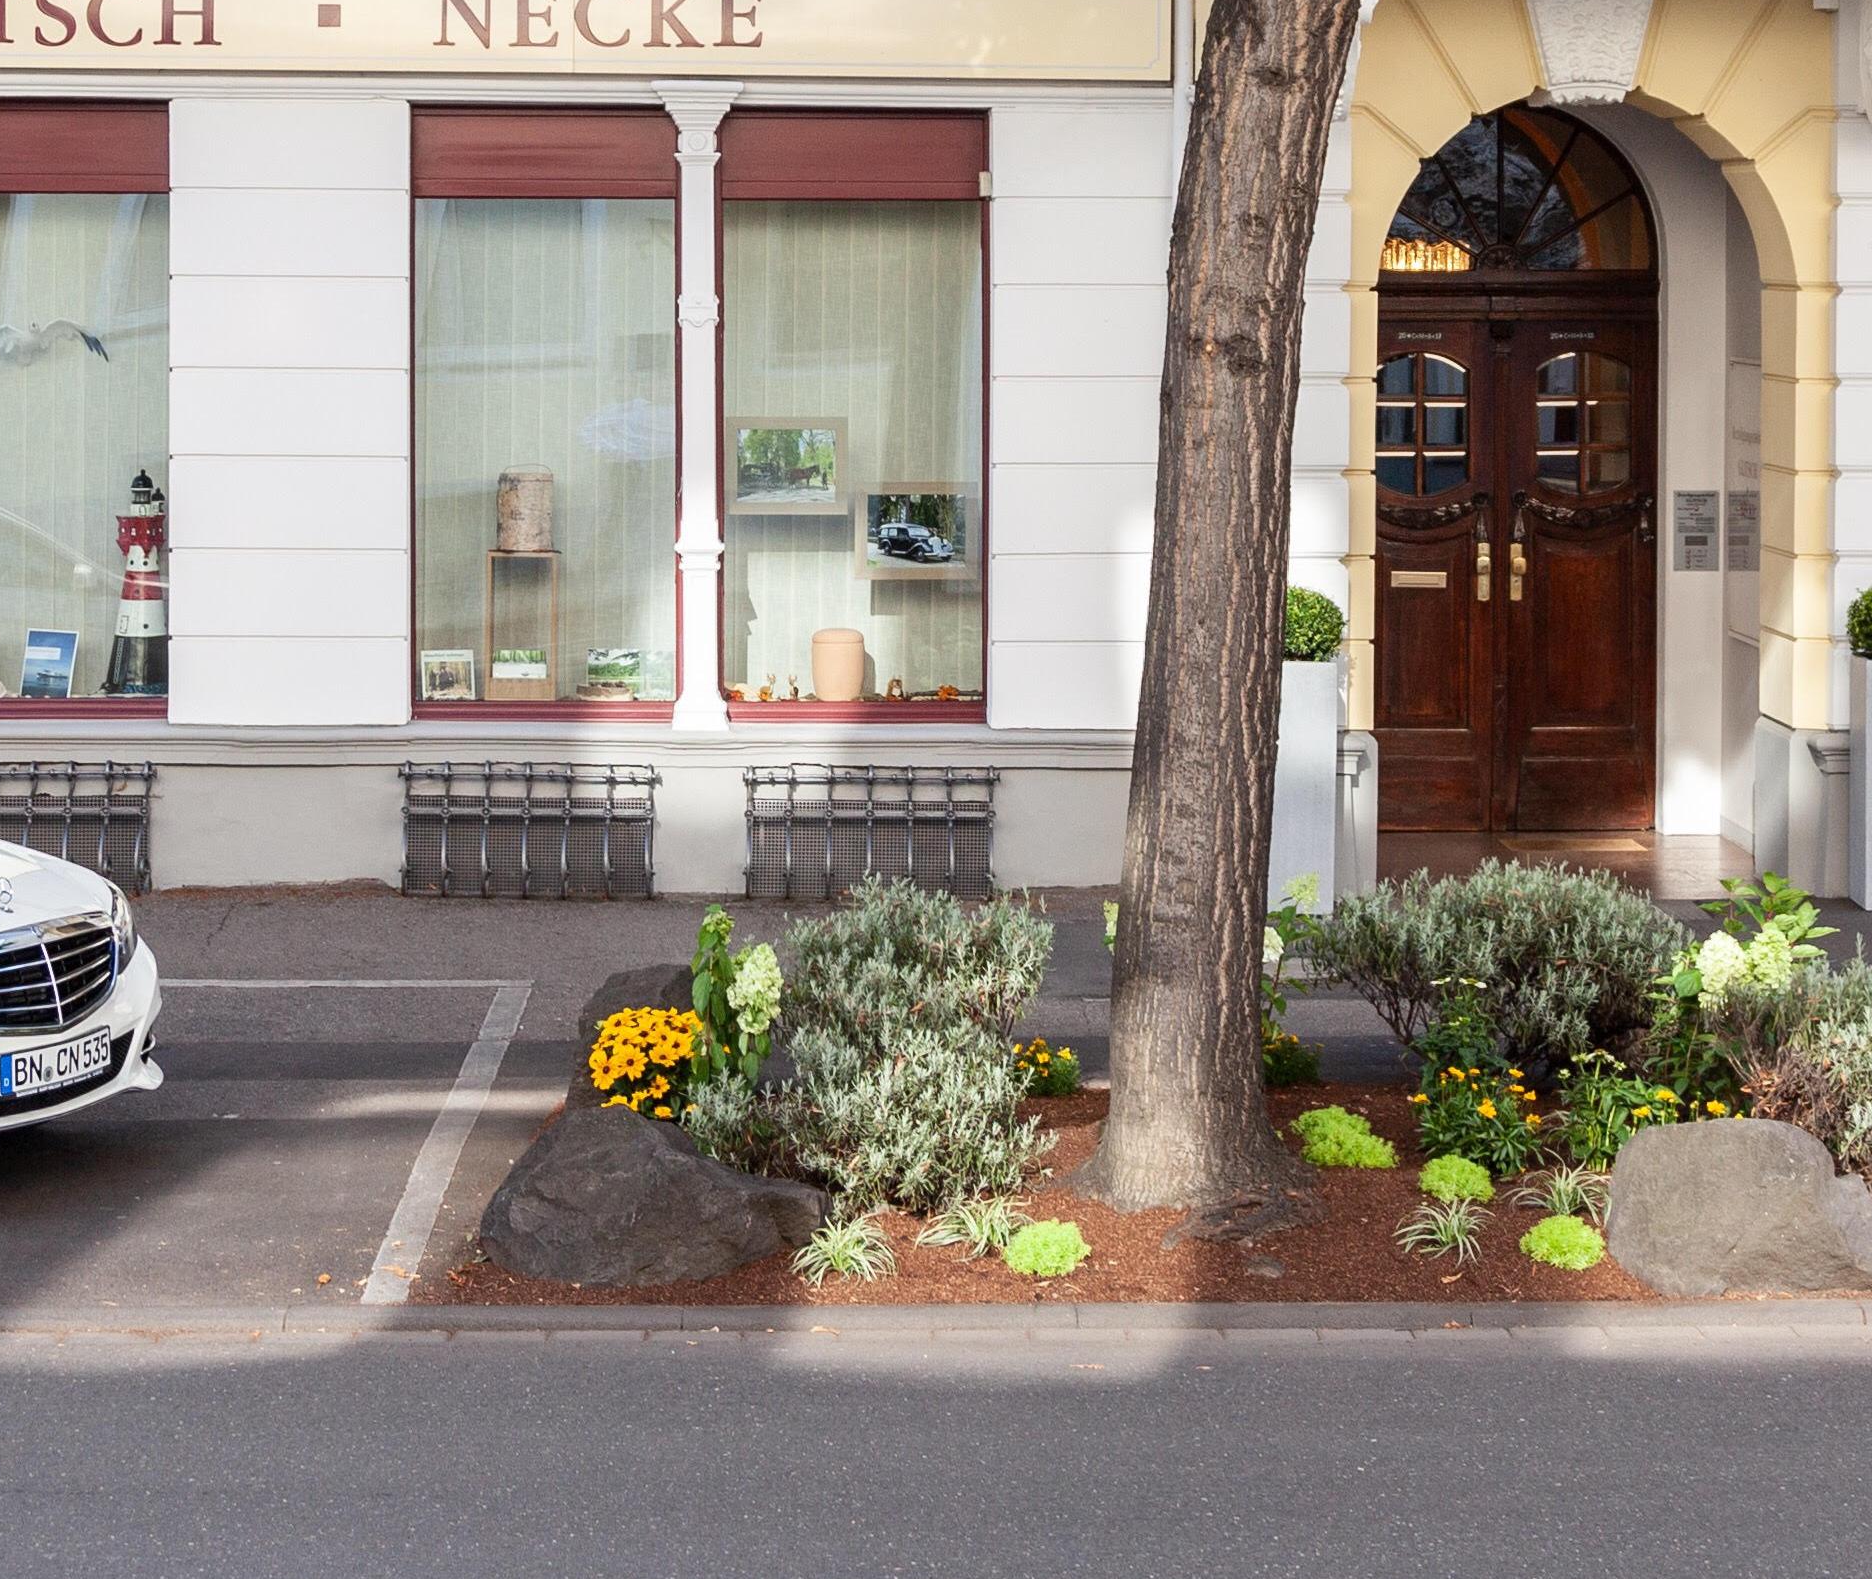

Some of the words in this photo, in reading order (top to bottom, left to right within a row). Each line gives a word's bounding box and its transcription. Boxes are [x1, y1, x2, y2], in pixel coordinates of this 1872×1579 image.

[15, 1053, 43, 1087] BN
[57, 1044, 79, 1076] CN
[83, 1033, 108, 1069] 535
